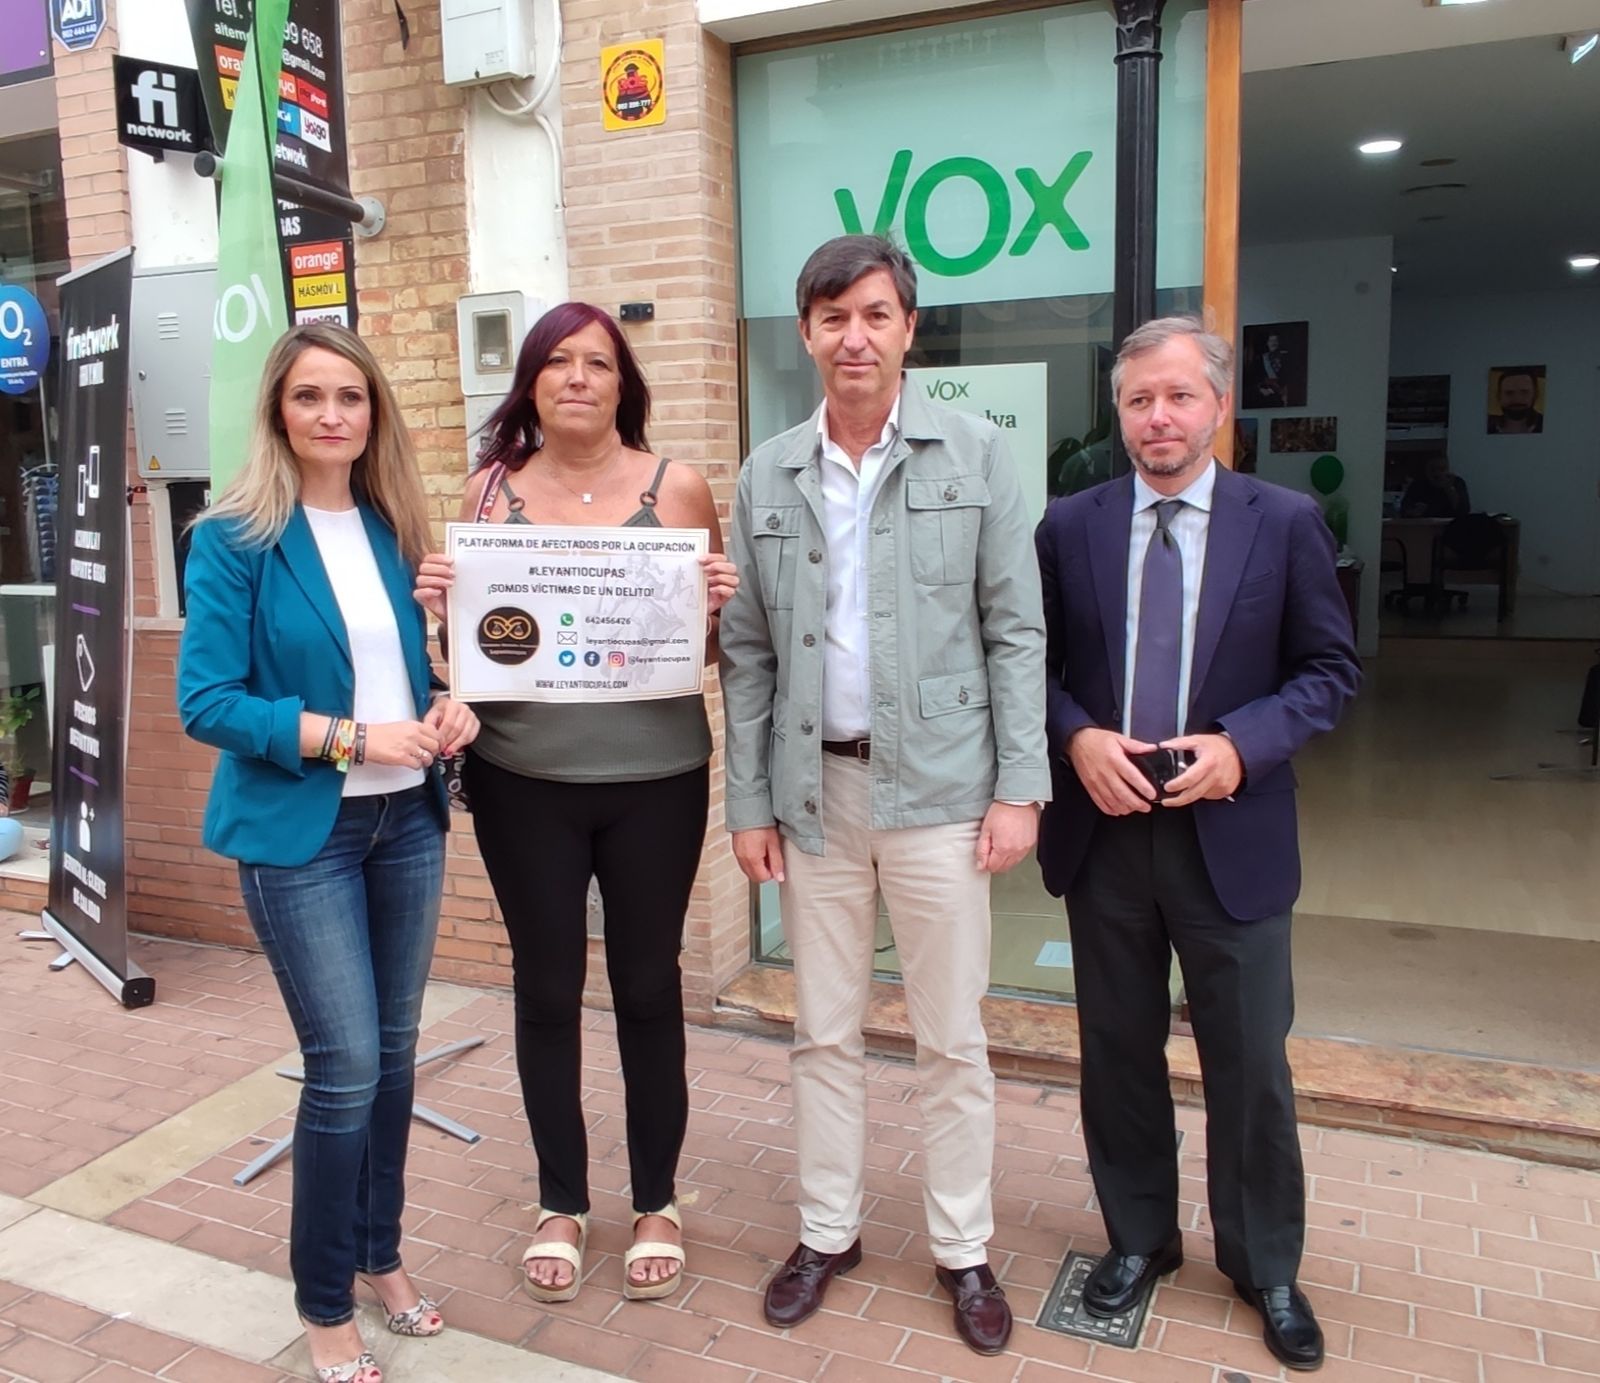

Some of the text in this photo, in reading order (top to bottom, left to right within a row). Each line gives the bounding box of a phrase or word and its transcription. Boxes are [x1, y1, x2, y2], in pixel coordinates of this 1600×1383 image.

[301, 28, 324, 59] 658
[126, 123, 193, 143] network
[833, 149, 1093, 277] VOX
[294, 251, 339, 271] orange
[1, 356, 29, 368] ENTRA
[927, 379, 970, 401] VOX
[985, 409, 1017, 429] lva
[457, 538, 696, 552] PLATAFORMA DE AFECTADOS POR LA OCUPACIÓN
[529, 566, 626, 578] #LEYANTIOCUPAS
[487, 583, 655, 597] ¡SOMOS VÍCTIMAS DE UN DELITO!
[586, 637, 689, 647] leyantiocupas@gmail.com
[628, 655, 691, 665] @leyantiocupas
[535, 679, 628, 689] WWW.LEYANTIOCUPAS.COM
